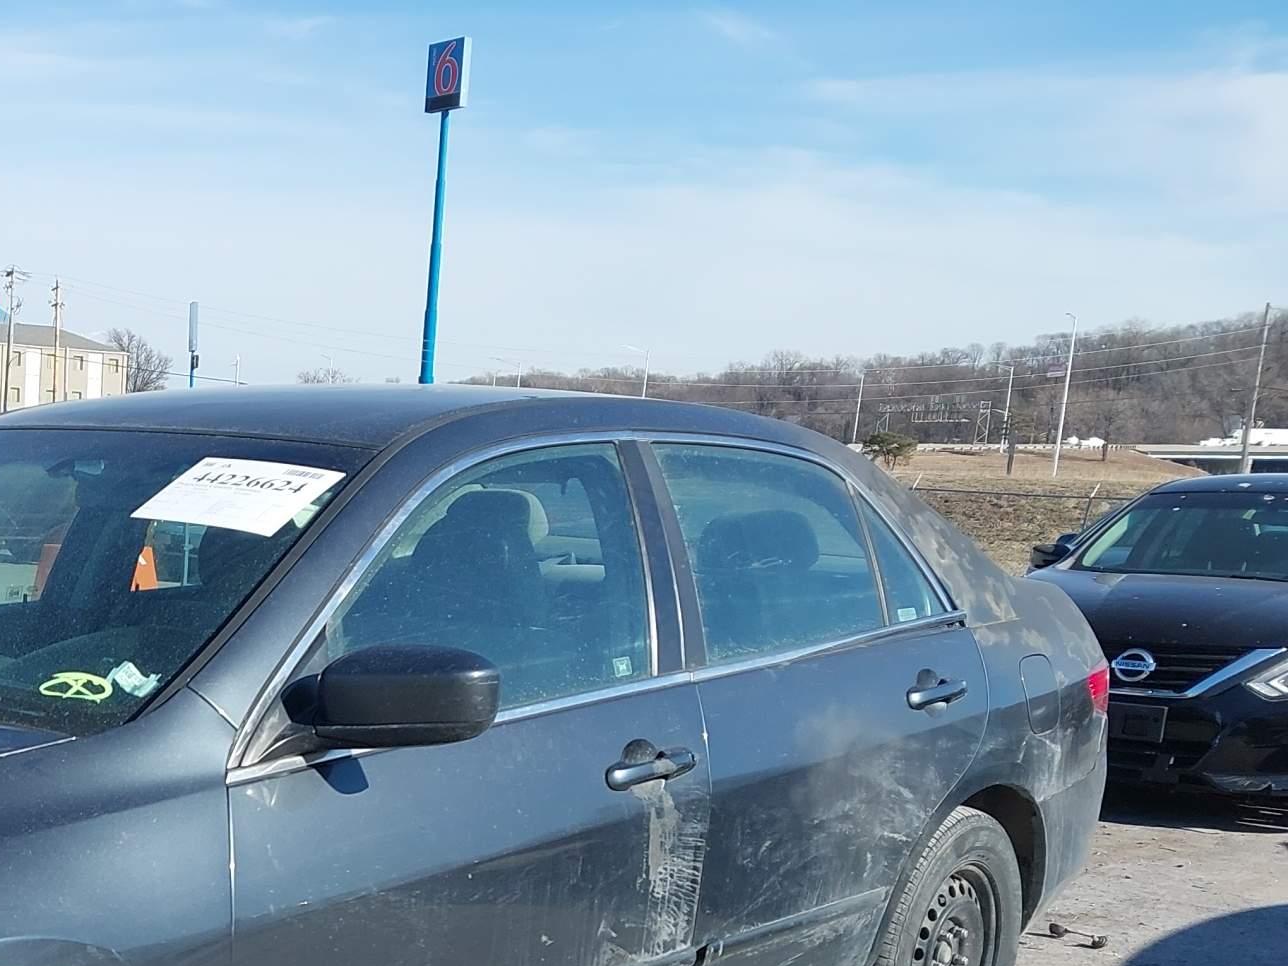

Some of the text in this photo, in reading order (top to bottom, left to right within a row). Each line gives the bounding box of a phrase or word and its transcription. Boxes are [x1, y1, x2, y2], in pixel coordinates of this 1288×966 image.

[434, 41, 458, 96] 6
[193, 471, 308, 493] 44226624
[1115, 660, 1151, 670] NISSAN
